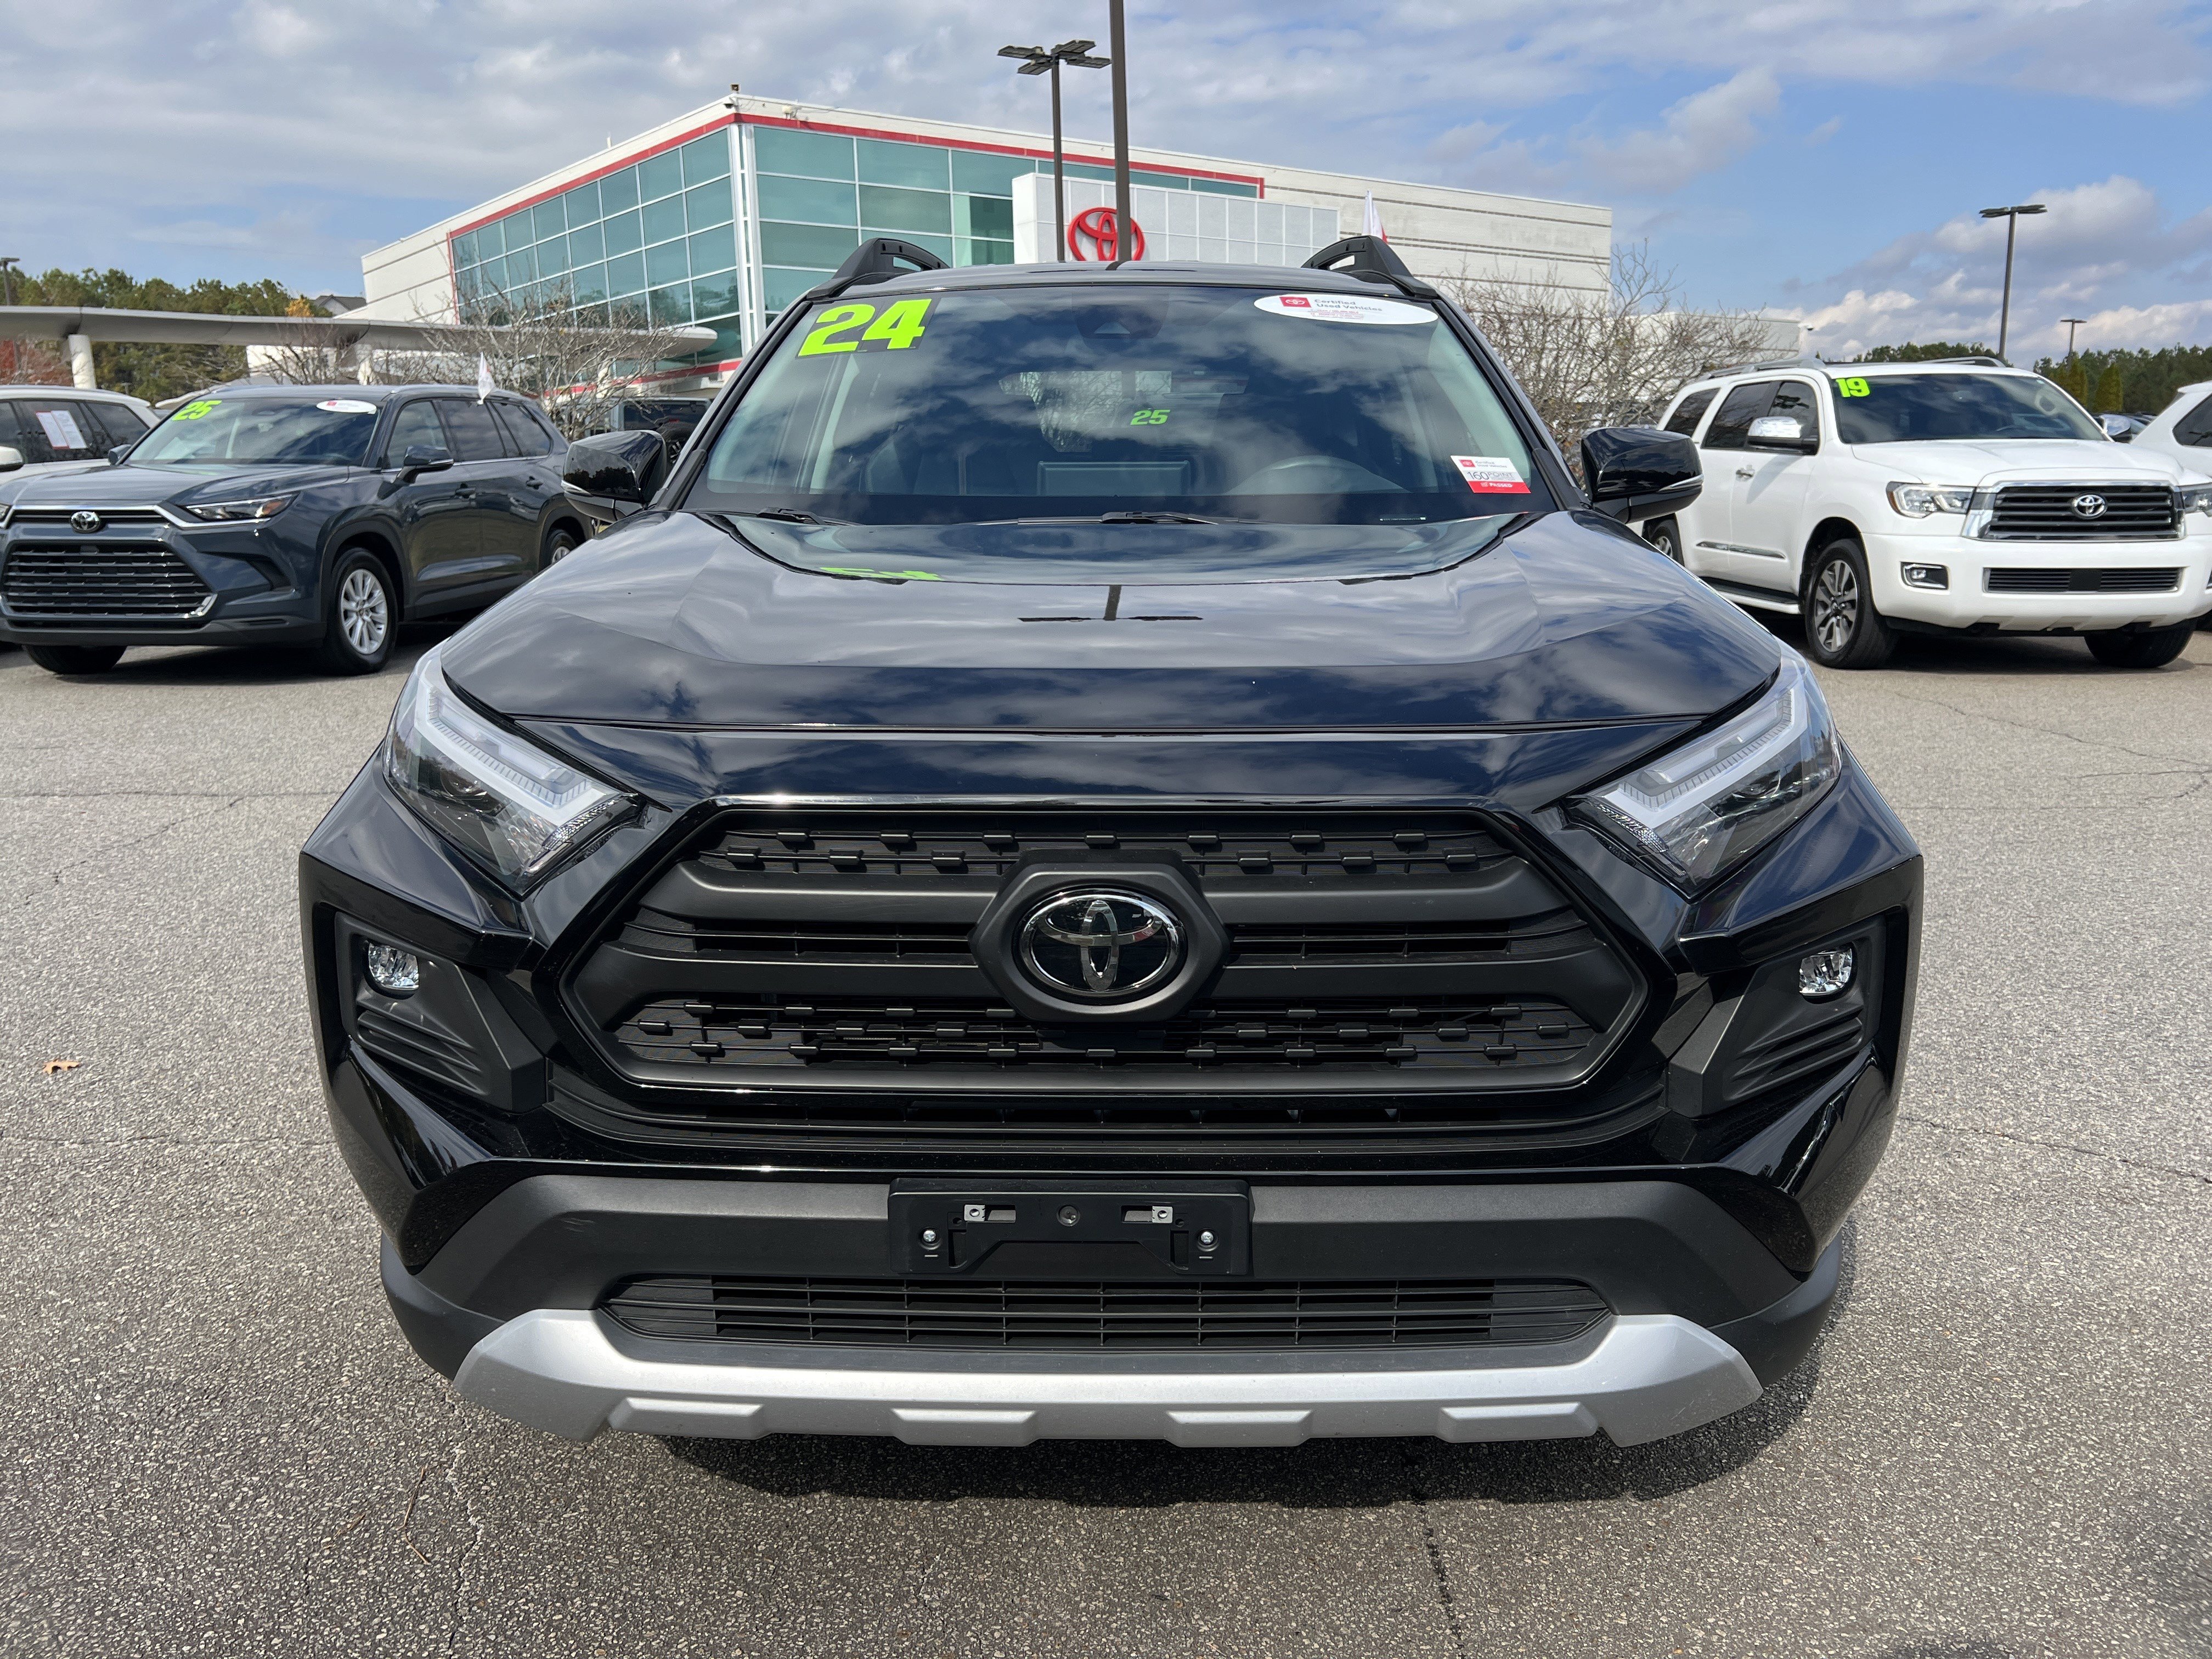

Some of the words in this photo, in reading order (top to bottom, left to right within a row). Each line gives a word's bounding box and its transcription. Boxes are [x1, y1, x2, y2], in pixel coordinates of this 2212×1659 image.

[798, 299, 932, 357] 24
[1836, 377, 1870, 398] 19
[172, 400, 222, 421] 25
[1131, 409, 1171, 425] 25
[1468, 471, 1489, 480] 160
